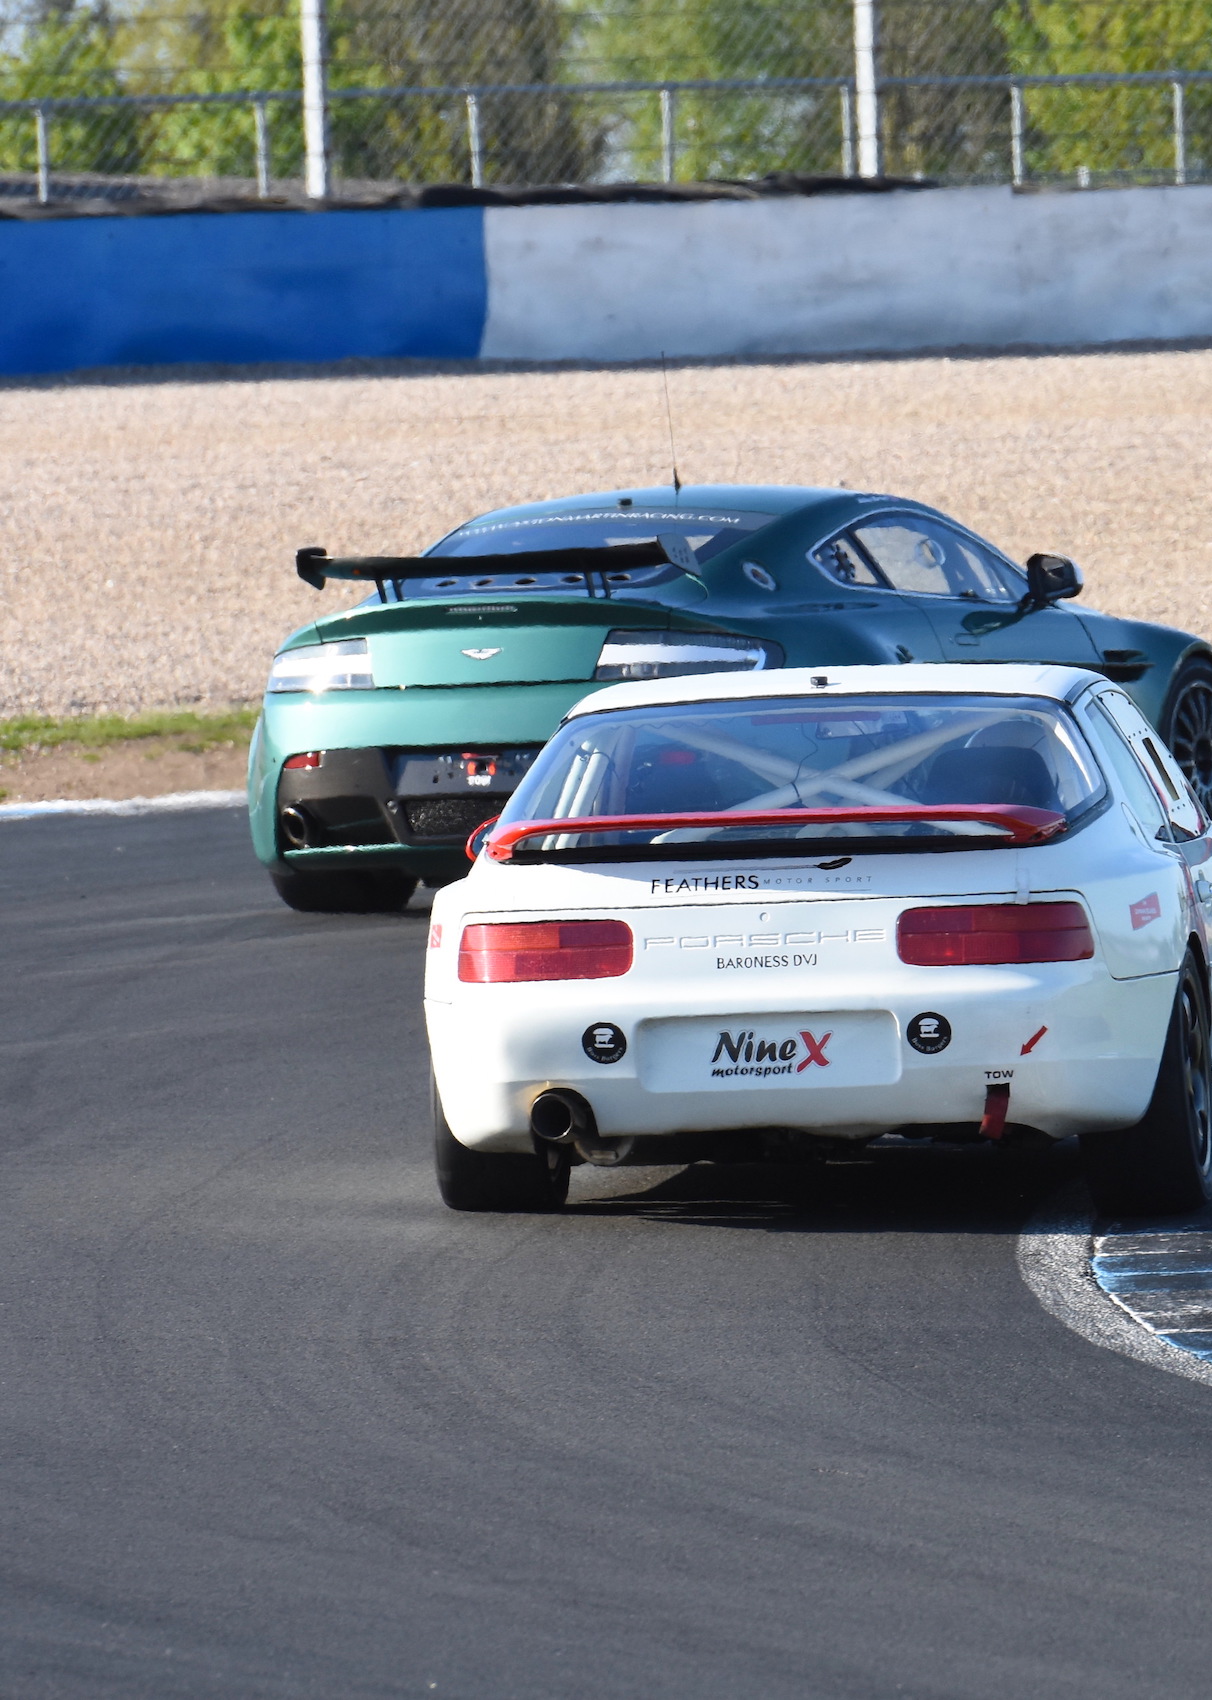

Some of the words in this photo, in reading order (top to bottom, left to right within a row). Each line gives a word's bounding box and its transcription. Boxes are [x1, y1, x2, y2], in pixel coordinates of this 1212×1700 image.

[651, 875, 760, 895] FEATHERS
[763, 877, 814, 885] MOTOR
[825, 875, 872, 883] SPORT
[643, 928, 886, 951] PORSCHE
[716, 954, 789, 970] BARONESS
[793, 953, 818, 968] DVJ
[711, 1063, 794, 1079] motorsport
[984, 1069, 1015, 1080] TOW
